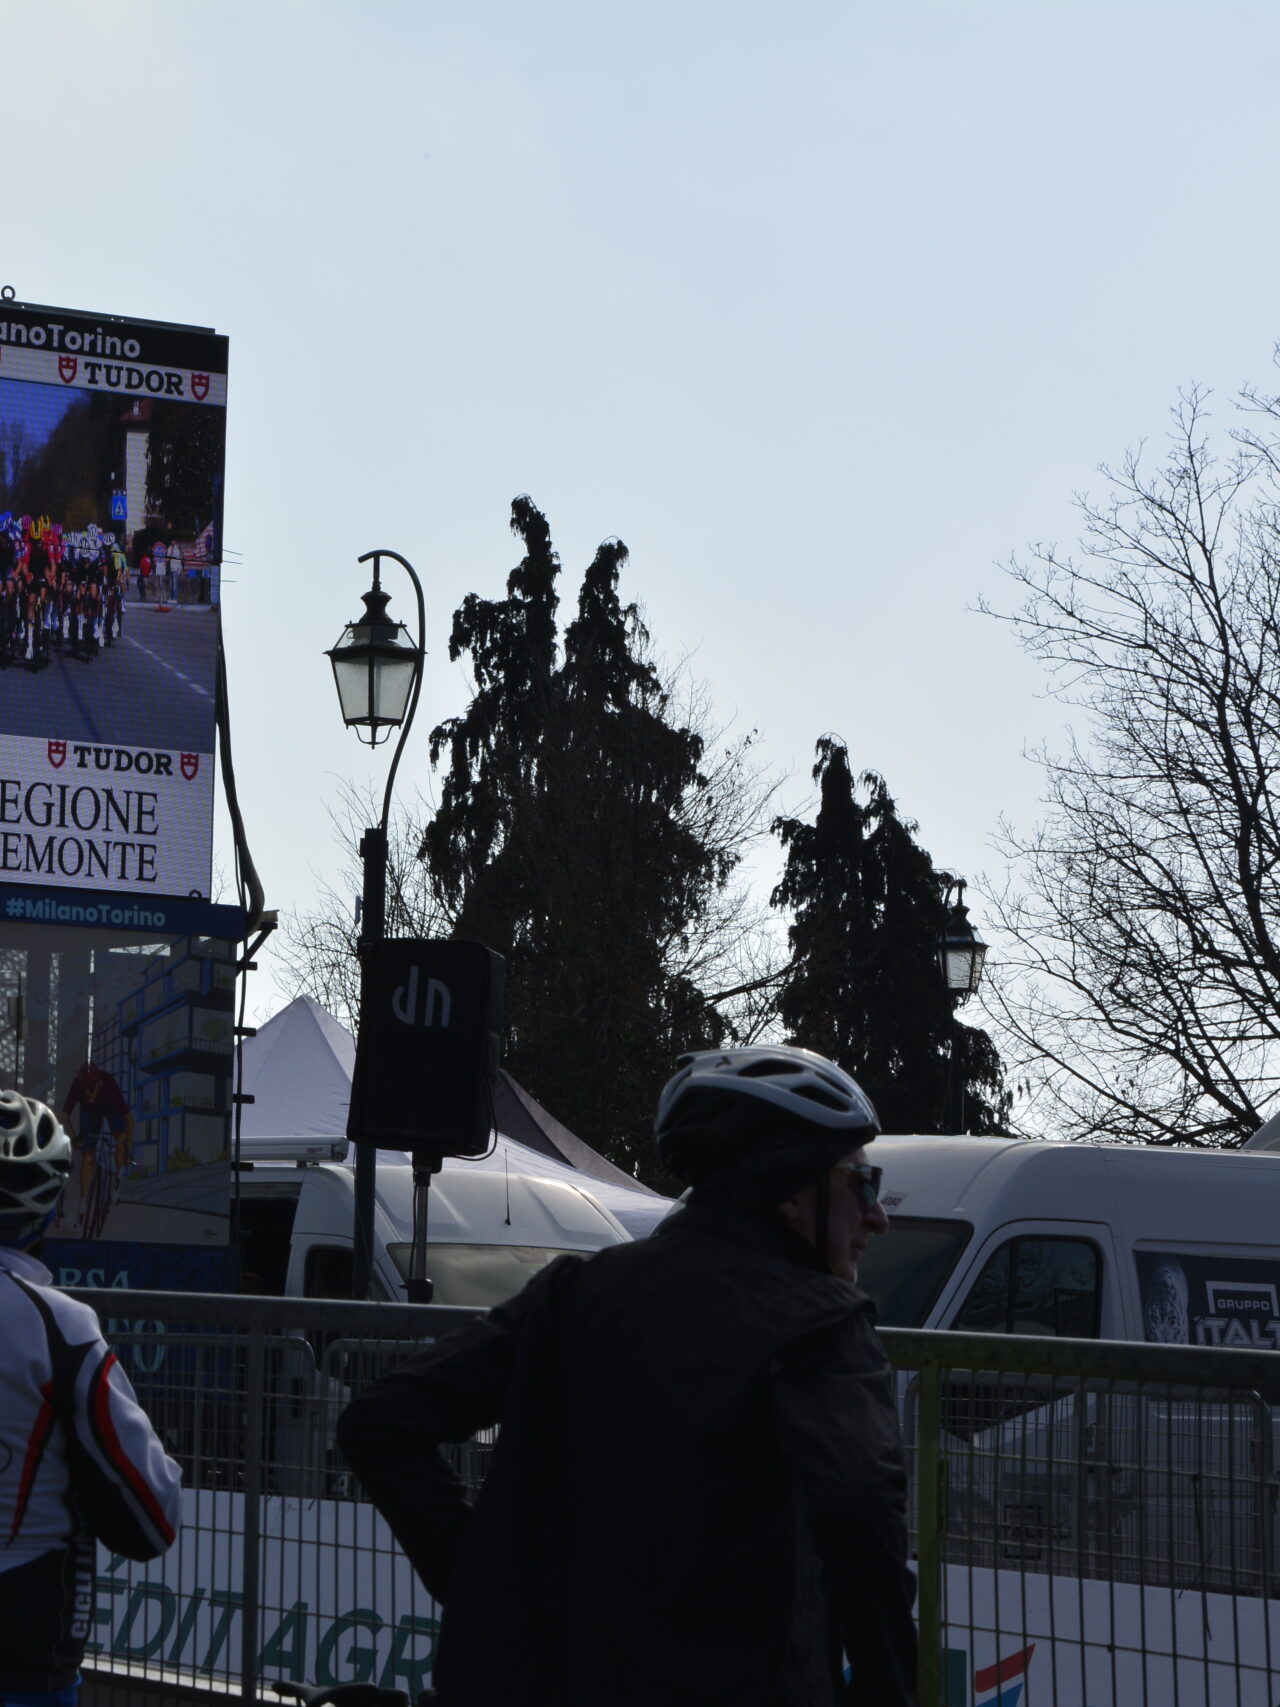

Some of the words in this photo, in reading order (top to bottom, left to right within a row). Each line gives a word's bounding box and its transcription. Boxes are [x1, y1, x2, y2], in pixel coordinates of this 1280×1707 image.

[83, 360, 185, 397] TUDOR
[73, 744, 174, 777] TUDOR
[5, 896, 167, 928] #MilanoTorino
[1216, 1298, 1271, 1311] GRUPPO
[82, 1555, 247, 1677] ÉDIT
